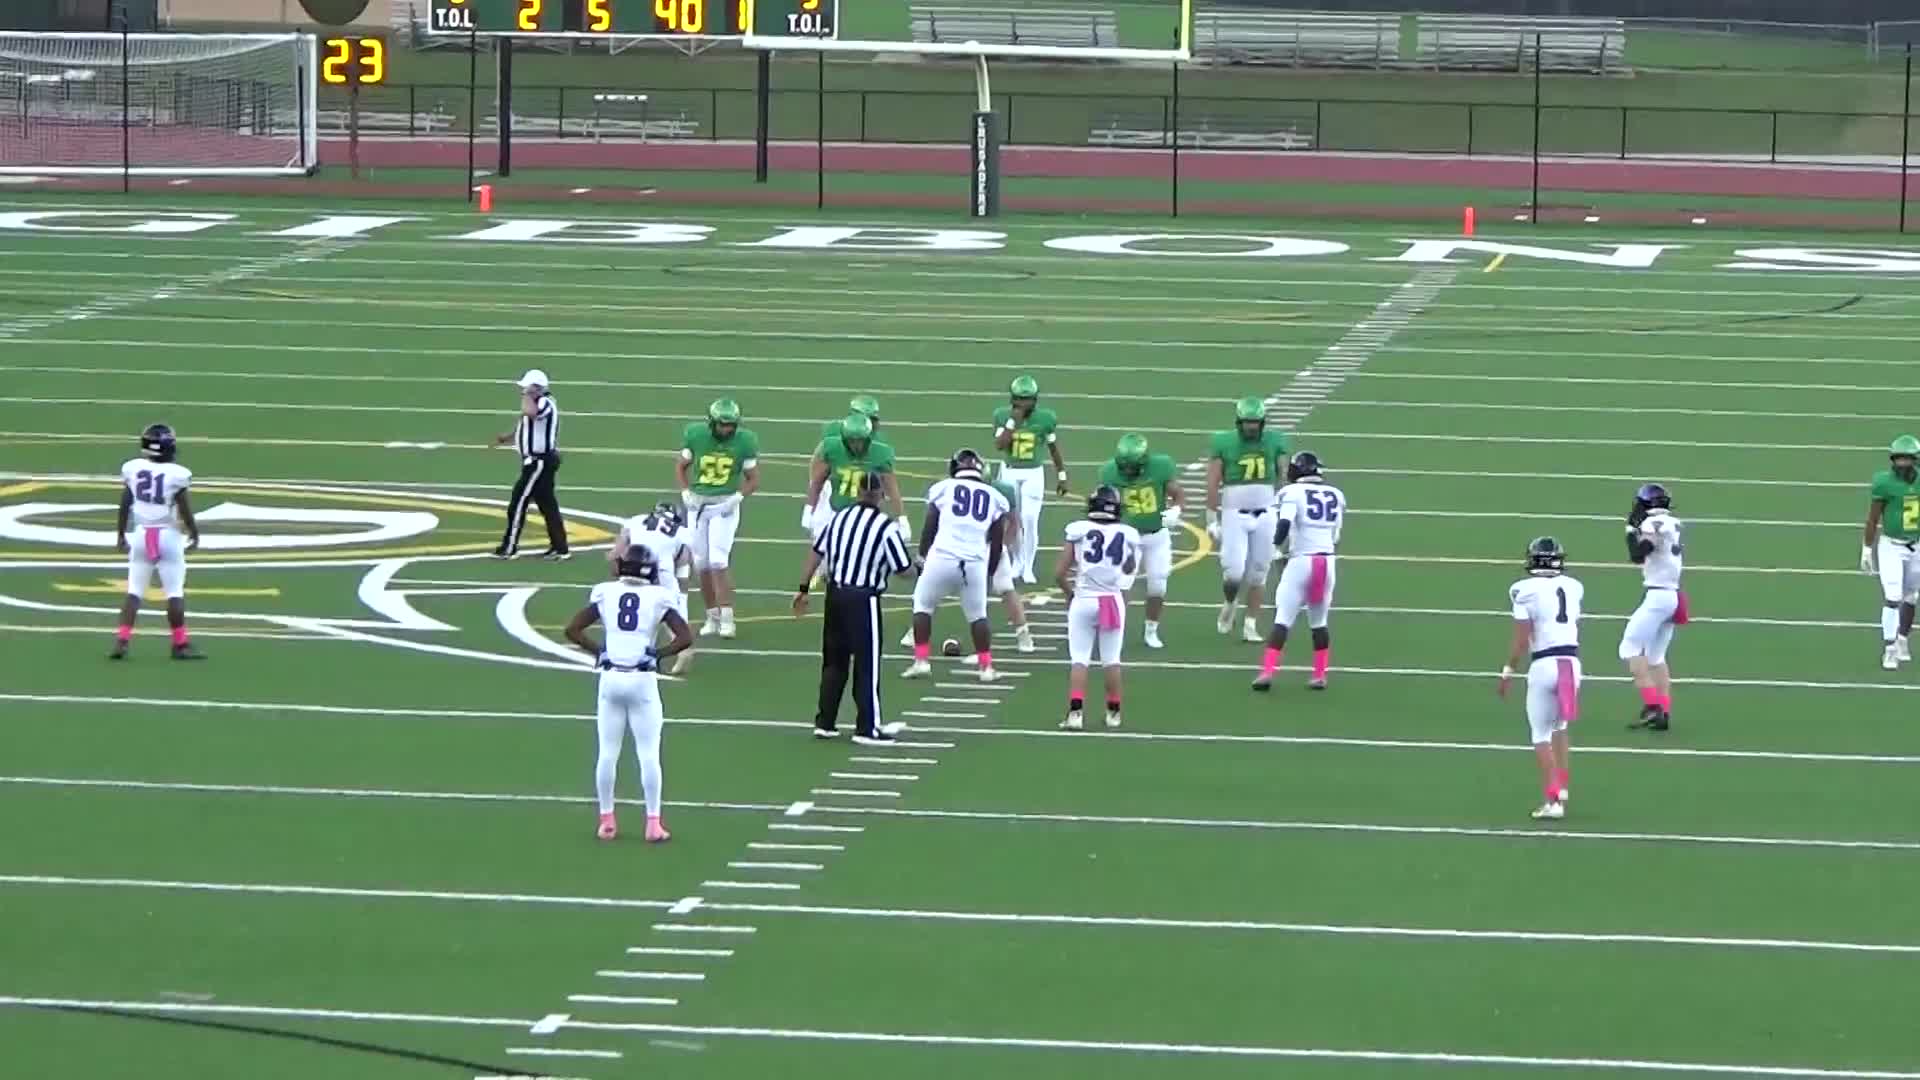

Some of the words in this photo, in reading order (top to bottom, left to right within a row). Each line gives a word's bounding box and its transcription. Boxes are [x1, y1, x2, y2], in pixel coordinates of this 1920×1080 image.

[323, 39, 382, 82] 23
[1012, 432, 1035, 459] 12
[136, 469, 165, 504] 21
[1238, 457, 1265, 480] 71
[951, 484, 990, 522] 90
[1305, 489, 1338, 522] 52
[1083, 529, 1125, 566] 34
[617, 592, 640, 631] 8
[1555, 586, 1568, 623] 1
